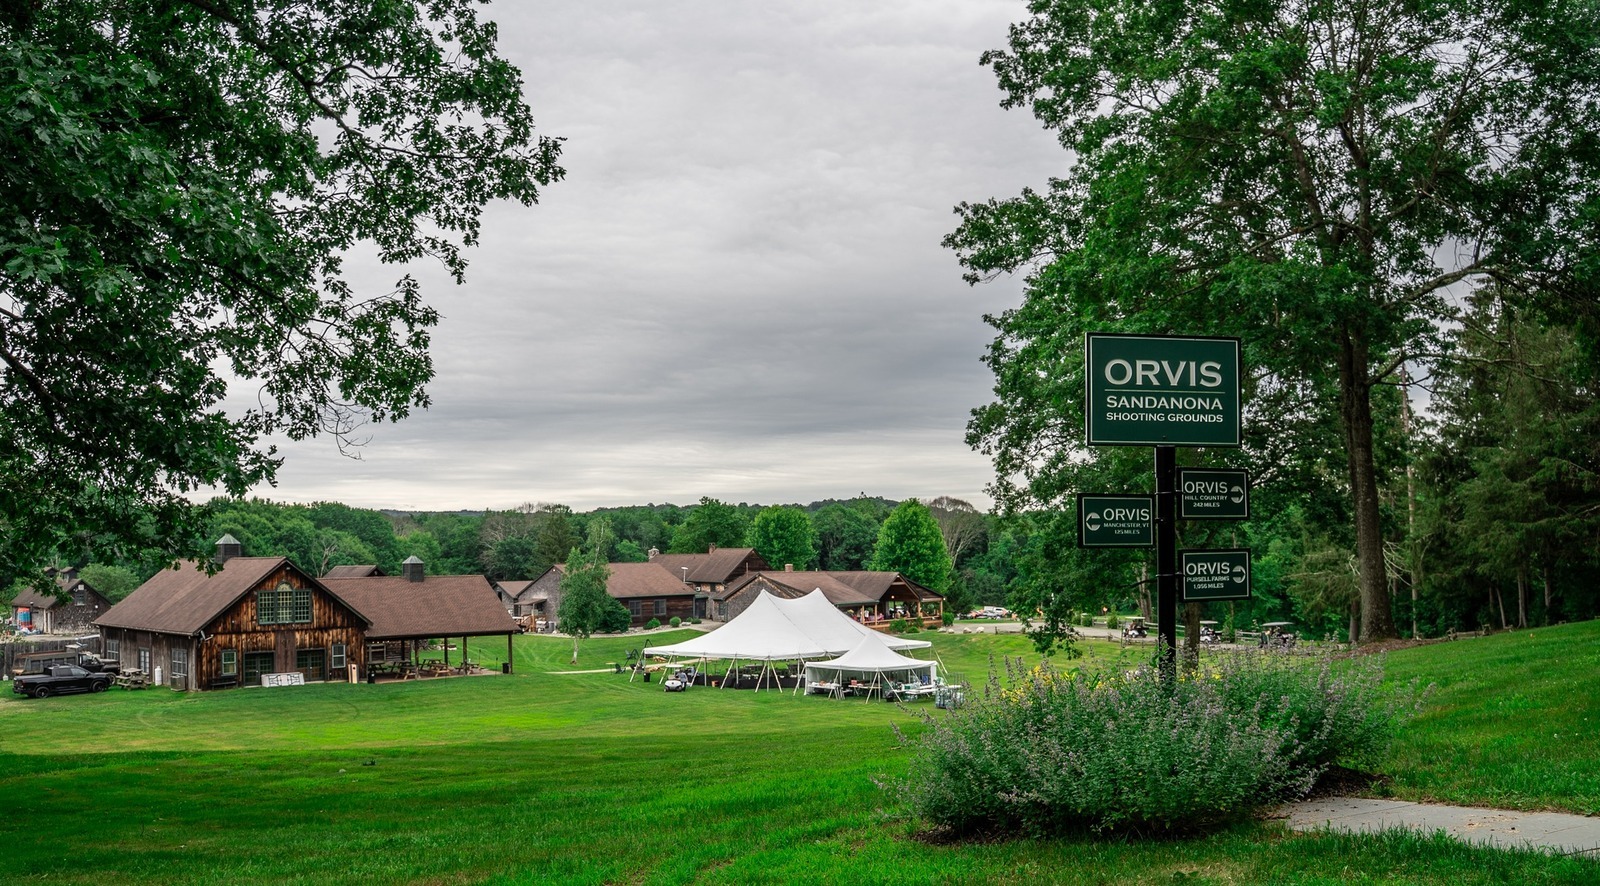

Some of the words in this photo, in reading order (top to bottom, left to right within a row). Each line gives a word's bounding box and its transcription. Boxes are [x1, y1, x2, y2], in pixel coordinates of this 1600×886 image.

[1104, 358, 1222, 388] ORVIS
[1106, 395, 1223, 410] SANDANONA
[1106, 412, 1165, 421] SHOOTING
[1167, 413, 1223, 423] GROUNDS
[1184, 481, 1228, 494] ORVIS
[1103, 508, 1150, 521] ORVIS
[1186, 561, 1230, 575] ORVIS
